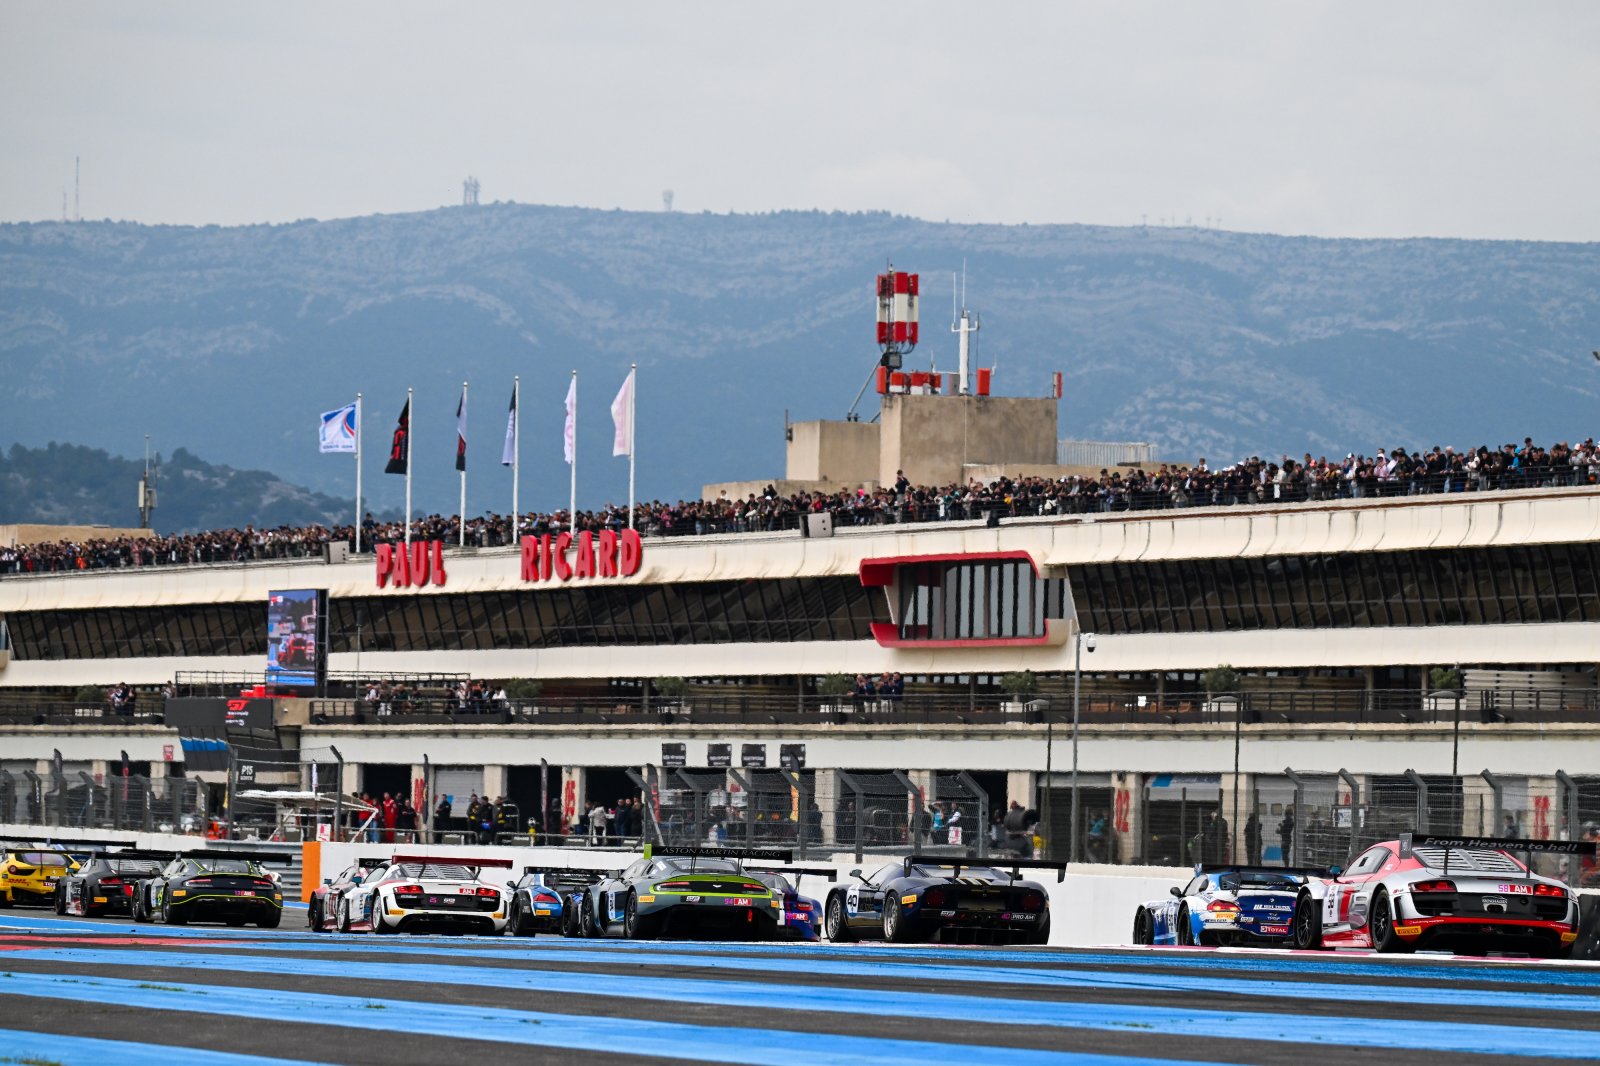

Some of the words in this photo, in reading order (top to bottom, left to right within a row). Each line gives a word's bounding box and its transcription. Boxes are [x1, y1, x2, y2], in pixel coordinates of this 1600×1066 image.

[376, 540, 446, 588] PAUL
[521, 528, 641, 581] RICARD
[1424, 837, 1462, 847] From
[1468, 838, 1523, 849] Heaven
[1527, 842, 1544, 850] to
[1547, 843, 1578, 852] hell
[699, 848, 740, 856] MARTIN
[742, 849, 781, 857] RACING
[1498, 884, 1509, 892] 58
[848, 895, 857, 907] 40
